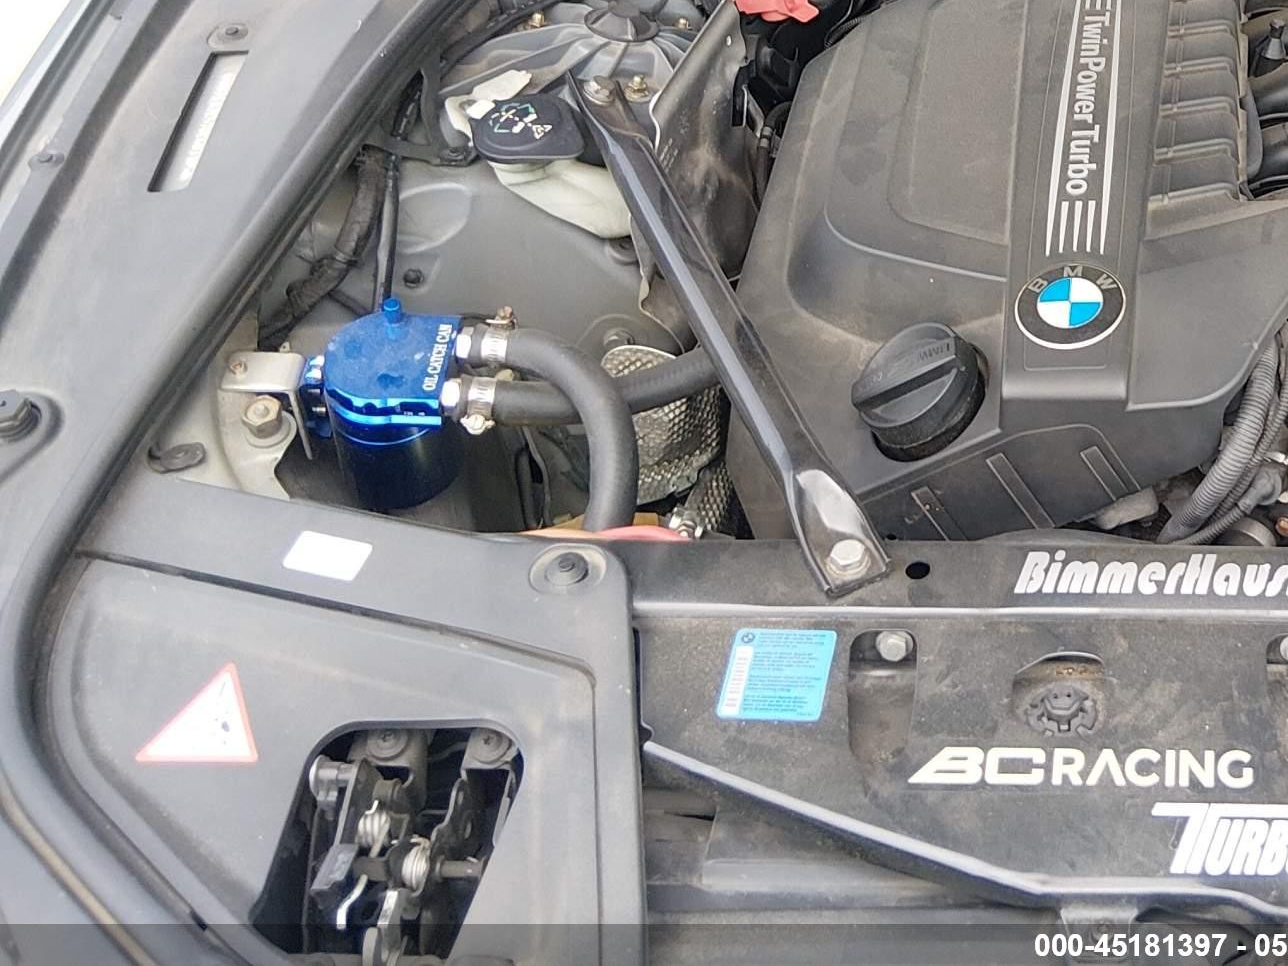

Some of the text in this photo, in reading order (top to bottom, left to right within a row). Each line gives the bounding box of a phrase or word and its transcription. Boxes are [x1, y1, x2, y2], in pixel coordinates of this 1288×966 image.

[1028, 265, 1118, 293] BMW
[422, 324, 452, 390] OIL CATCH CAN
[1051, 748, 1254, 789] RACING
